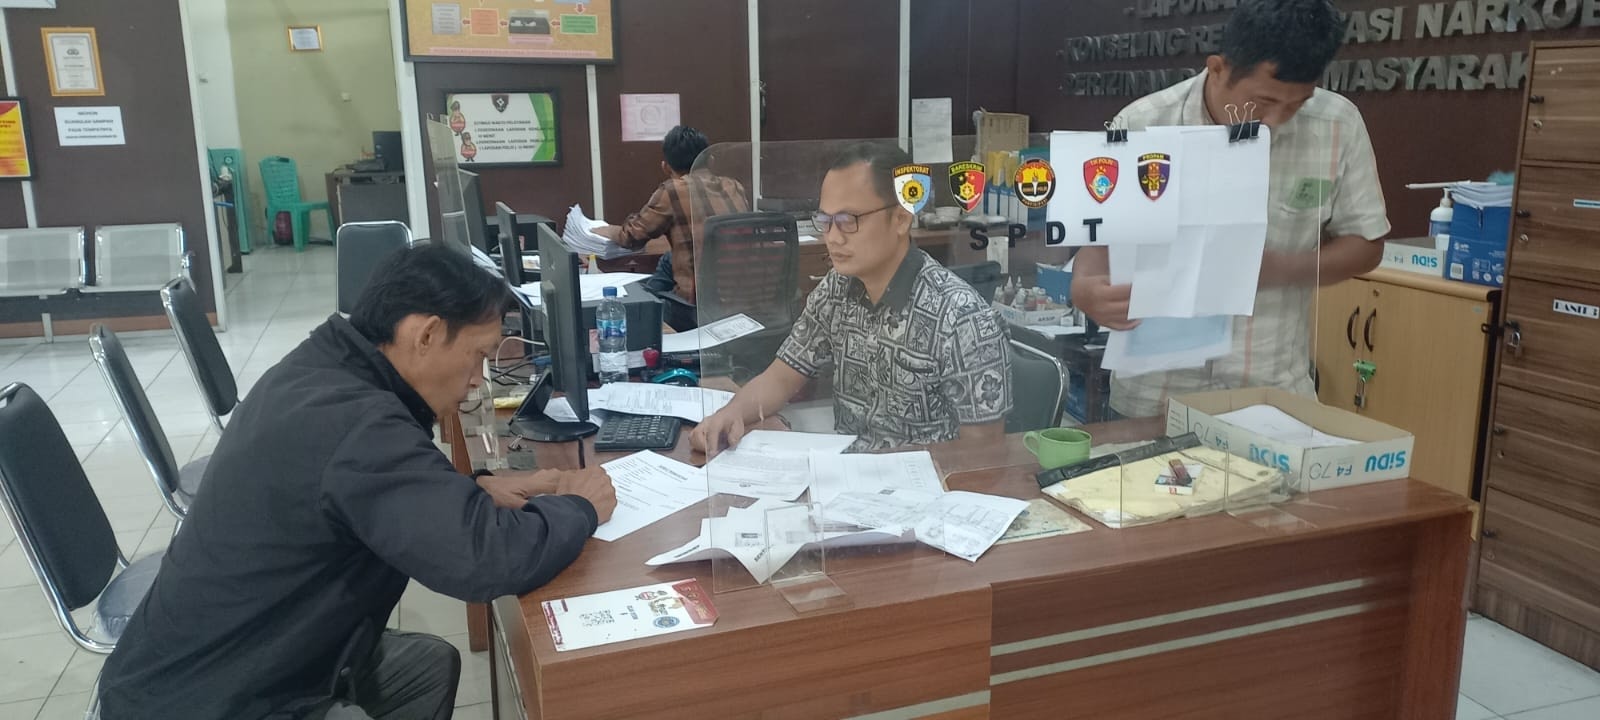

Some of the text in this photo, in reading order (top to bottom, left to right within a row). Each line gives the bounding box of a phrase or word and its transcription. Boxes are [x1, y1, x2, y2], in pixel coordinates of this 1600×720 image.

[1064, 28, 1187, 61] KONSELING
[894, 165, 930, 176] INSPEKTORAT
[1365, 450, 1407, 472] SiDU
[1336, 464, 1353, 477] F4
